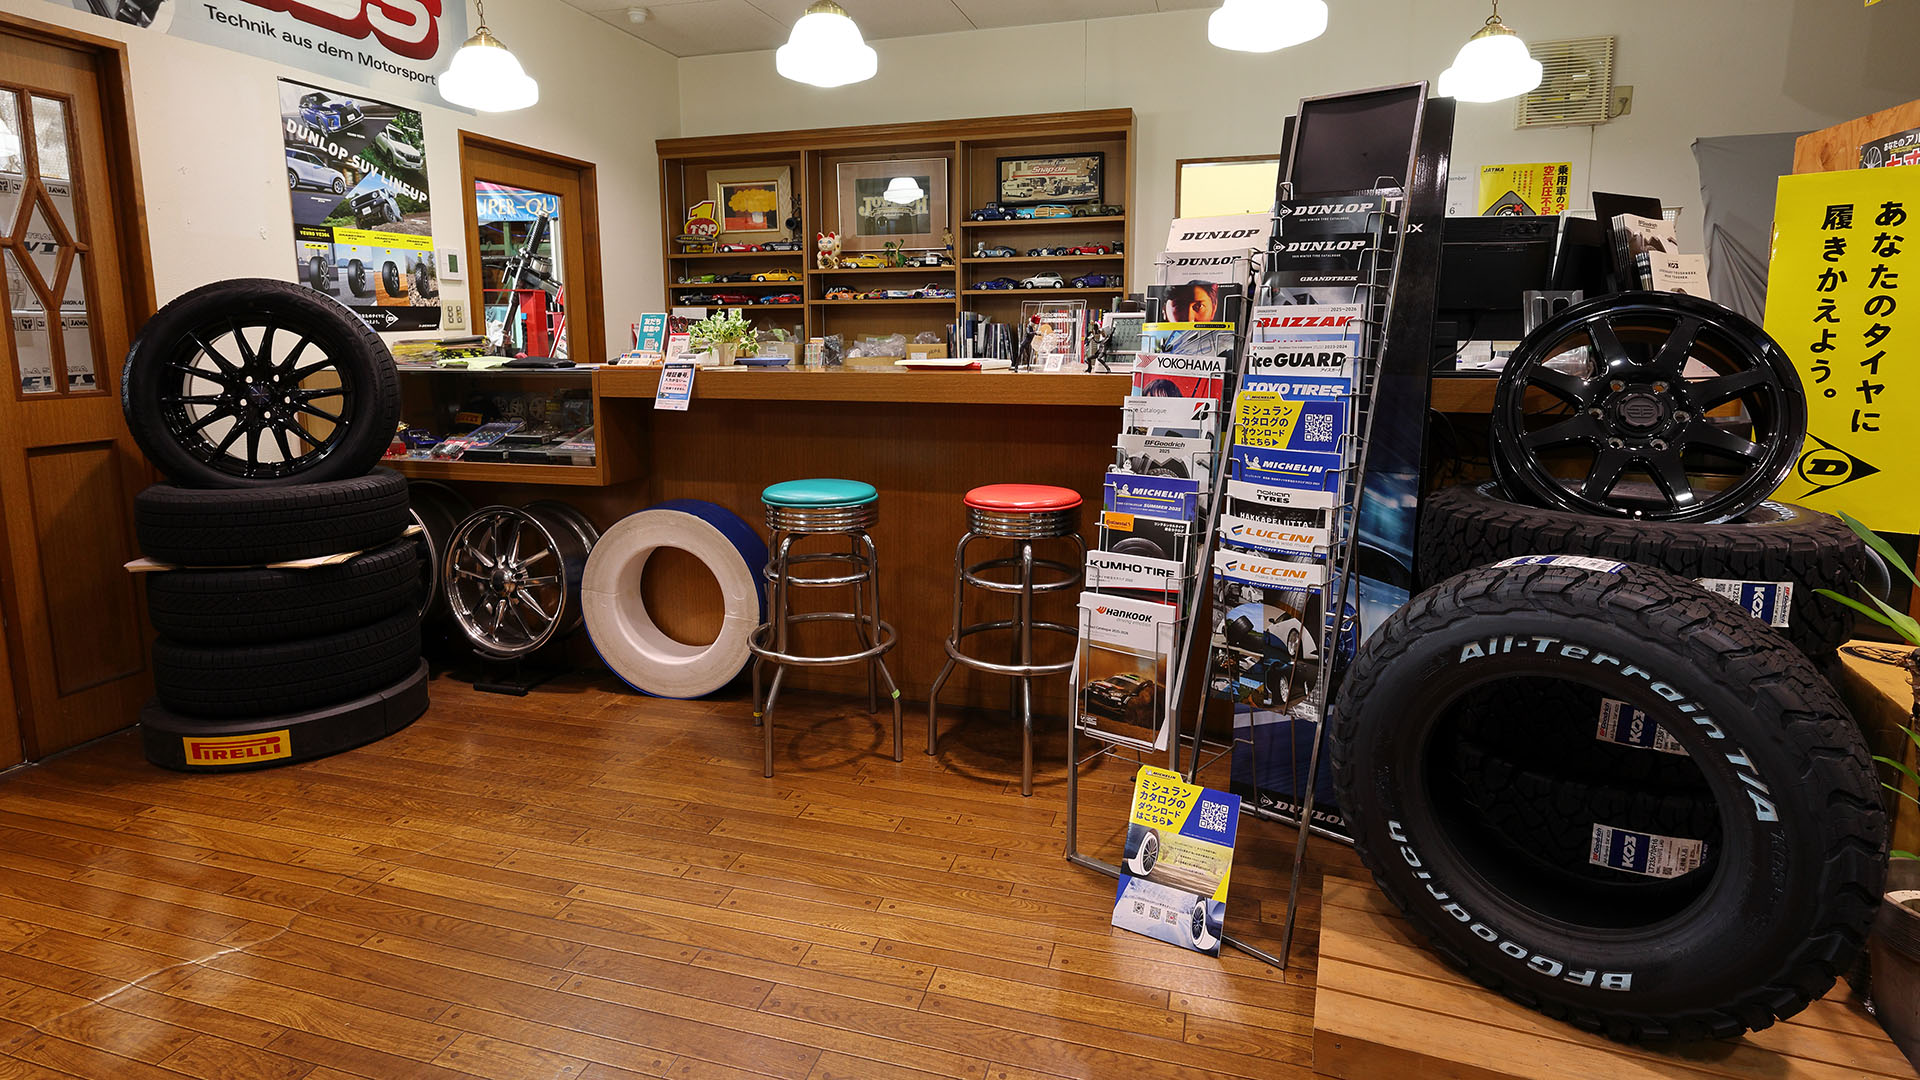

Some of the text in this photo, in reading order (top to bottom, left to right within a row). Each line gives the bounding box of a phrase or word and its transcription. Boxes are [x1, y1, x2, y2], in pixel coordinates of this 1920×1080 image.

[204, 4, 436, 85] Technik aus dem Motorsport
[287, 118, 428, 204] DUNLOP SUV LINEUP
[1032, 166, 1067, 174] Snap-on
[48, 186, 67, 194] JAWA
[1293, 203, 1374, 216] DUNLOP
[1450, 207, 1455, 215] 6
[690, 224, 718, 235] TOP
[1180, 229, 1260, 241] DUNLOP
[1286, 240, 1366, 252] DUNLOP
[1810, 204, 1855, 399] 履きかえよう。
[1256, 316, 1355, 328] BLIZZAK
[1851, 200, 1908, 433] あなたのタイヤに
[1158, 357, 1221, 372] YOKOHAMA
[1247, 382, 1345, 397] TOYO TIRES
[1242, 405, 1293, 417] ミシュラン
[1242, 416, 1289, 427] カタログの
[1241, 428, 1285, 438] ダウンロード
[1144, 440, 1185, 448] BFGoodrich
[1241, 438, 1272, 447] はこちら
[1263, 460, 1324, 473] MICHELIN
[1132, 488, 1185, 499] MICHELIN
[1256, 490, 1290, 498] nokian
[1257, 495, 1290, 504] TYRES
[1246, 527, 1314, 544] LUCCINI
[1090, 560, 1142, 573] KUMHO
[1144, 566, 1175, 578] TIRE
[1240, 563, 1308, 579] LUCCINI
[1458, 636, 1781, 823] All-Terrain T/A
[190, 736, 281, 760] PIRELLI
[1153, 772, 1176, 780] MICHELIN
[1142, 779, 1192, 798] ミシュラン
[1140, 791, 1186, 810] カタログの
[1138, 802, 1182, 819] ダウンロード
[1136, 811, 1166, 825] はこちら
[1592, 828, 1602, 861] BFGoodrich
[1622, 835, 1637, 868] KO3
[1648, 839, 1659, 874] LT235/70R16
[1388, 819, 1634, 992] BFGoodrich
